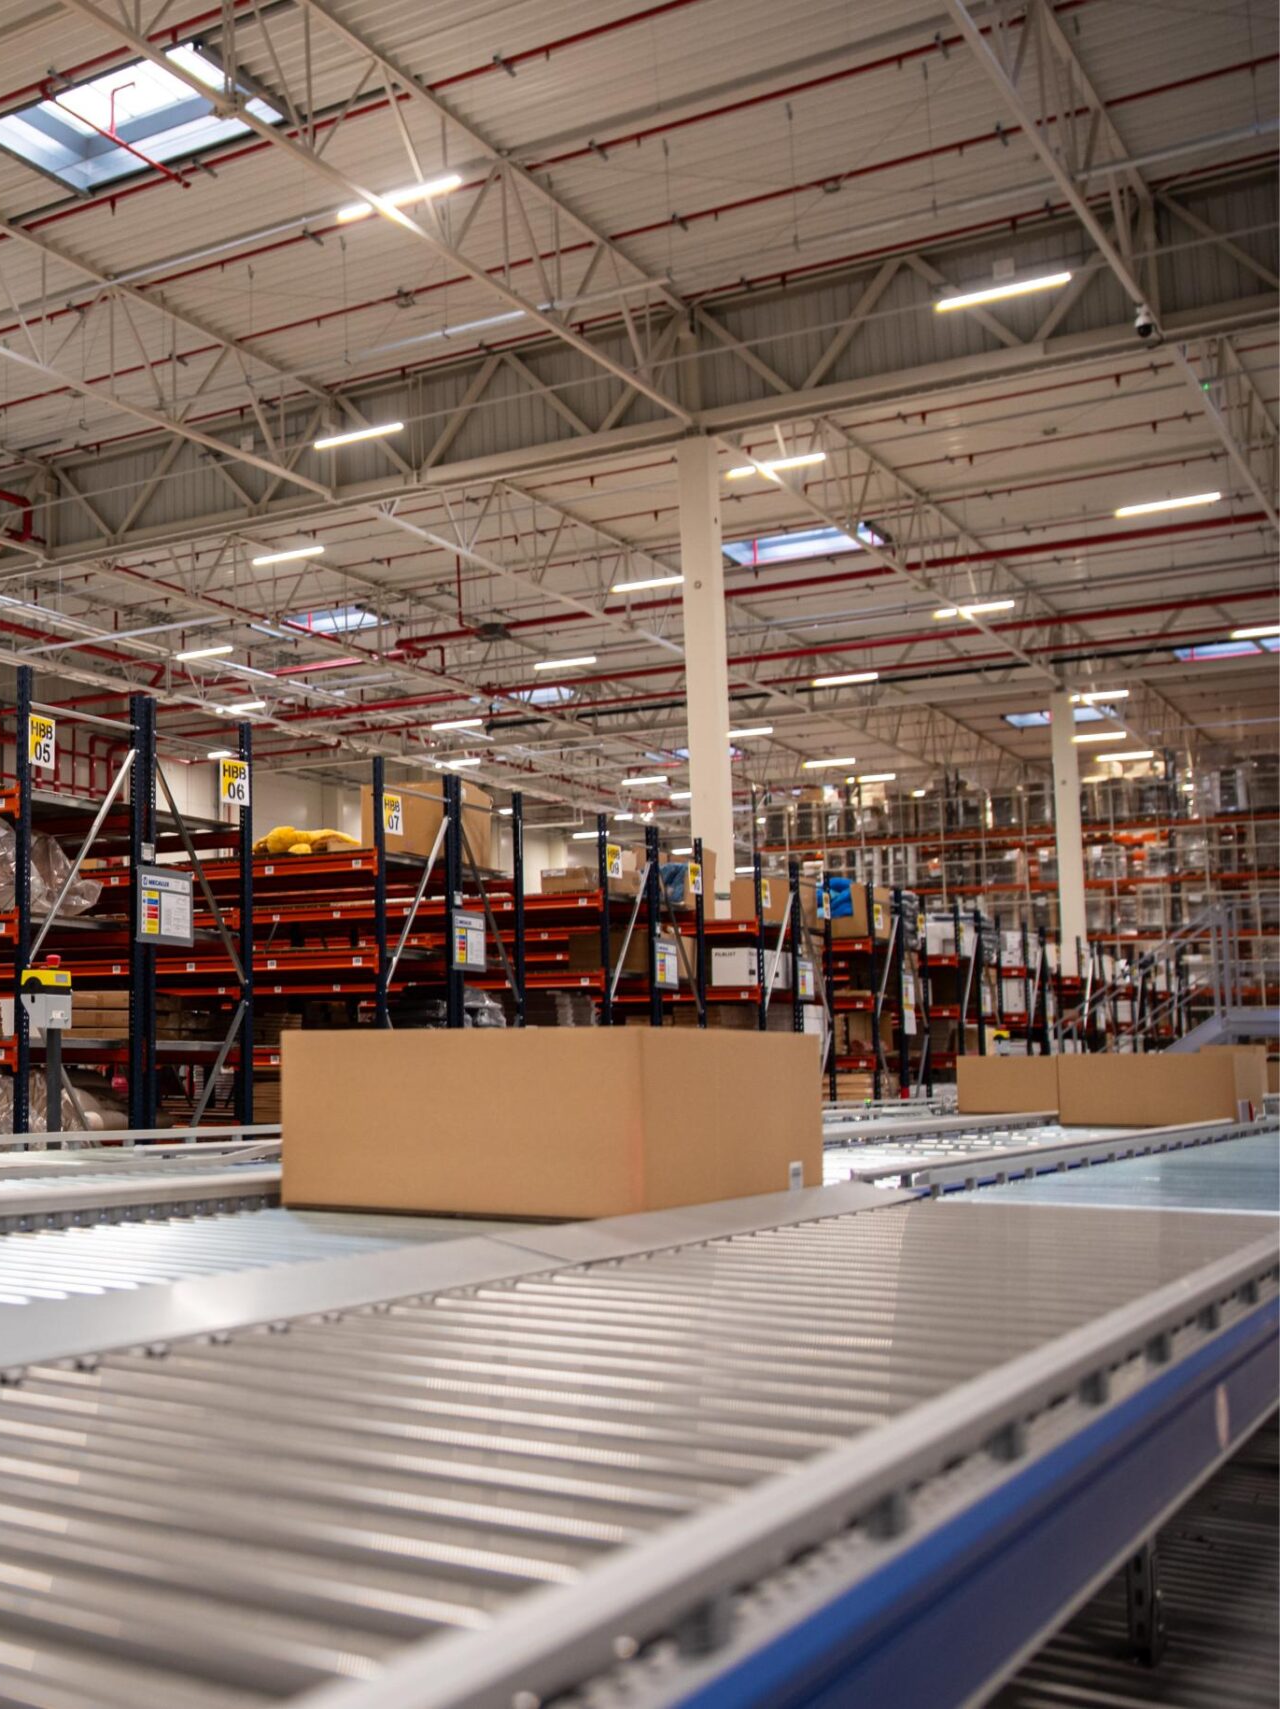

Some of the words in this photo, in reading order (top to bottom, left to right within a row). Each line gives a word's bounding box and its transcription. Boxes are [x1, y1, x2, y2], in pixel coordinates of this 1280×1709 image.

[31, 720, 53, 740] HBB
[34, 741, 51, 763] 05
[223, 764, 247, 780] HBB
[227, 782, 245, 801] 06
[384, 798, 400, 812] HBB
[388, 815, 399, 830] 07
